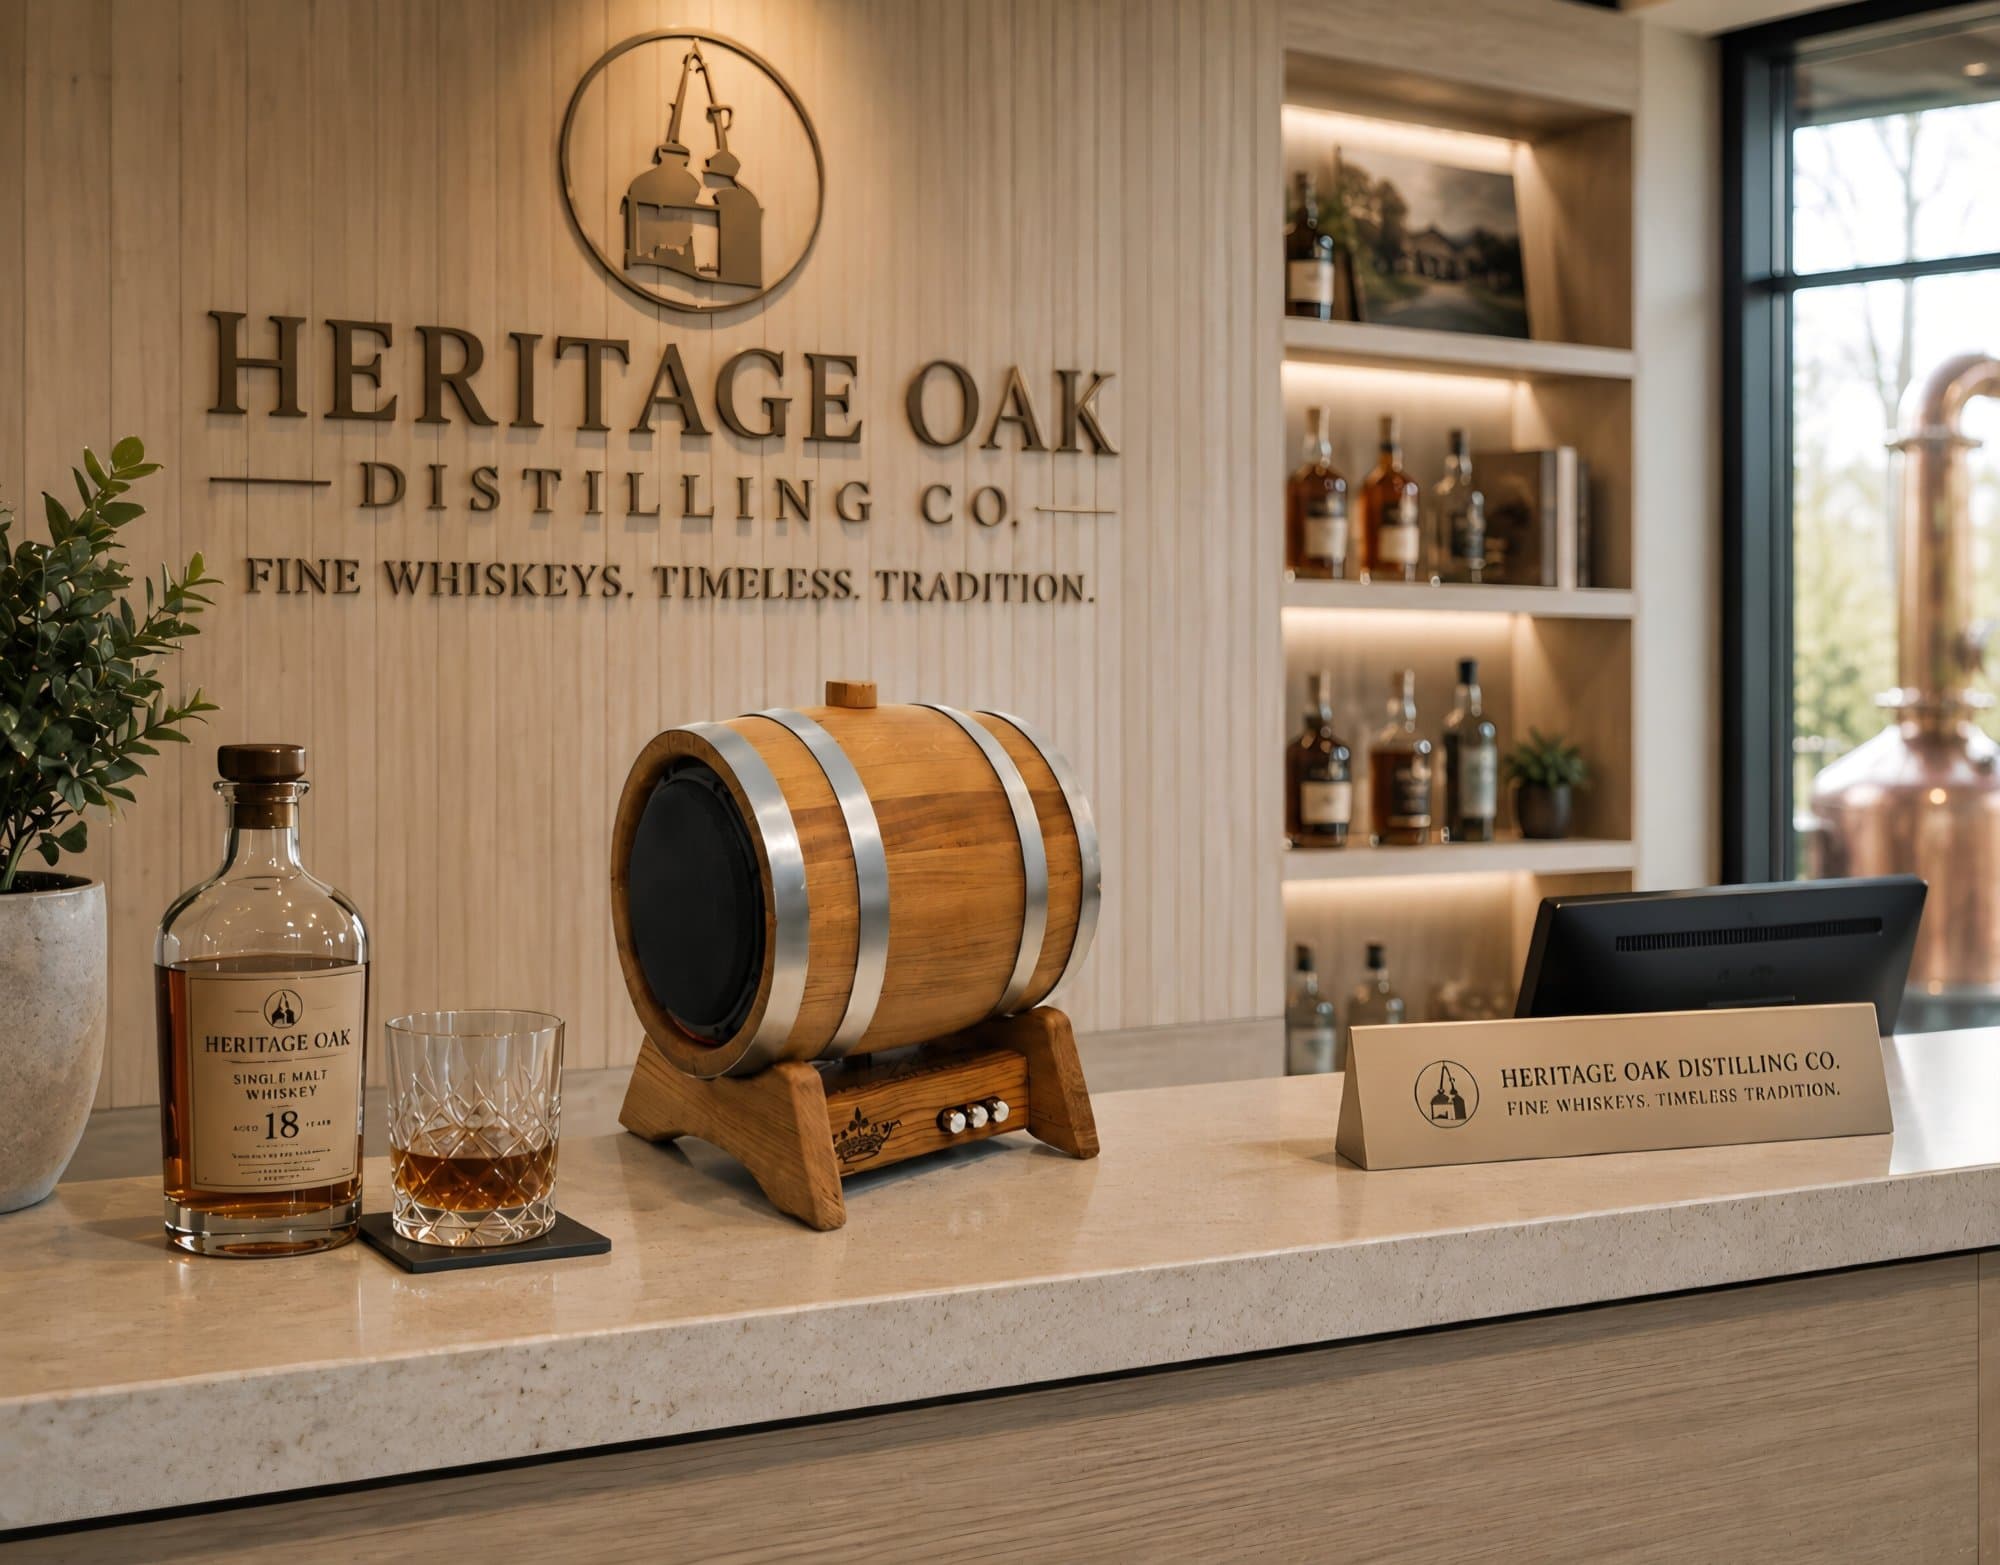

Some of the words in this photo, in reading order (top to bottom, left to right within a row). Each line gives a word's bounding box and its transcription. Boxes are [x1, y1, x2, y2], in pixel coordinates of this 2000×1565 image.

[207, 310, 863, 444] HERITAGE
[905, 359, 1120, 456] OAK
[359, 461, 872, 525] DISTILLING
[920, 484, 1020, 528] CO.
[247, 557, 361, 594] FINE
[383, 559, 634, 600] WHISKEYS.
[652, 565, 860, 600] TIMELESS.
[875, 569, 1096, 603] TRADITION.
[205, 1034, 308, 1053] HERITAGE
[314, 1028, 351, 1049] OAK
[233, 1072, 286, 1086] SINGLE
[292, 1069, 328, 1083] MALT
[1501, 1063, 1616, 1088] HERITAGE
[1624, 1059, 1670, 1082] OAK
[1678, 1053, 1798, 1078] DISTILLING
[1805, 1051, 1840, 1071] CO.
[246, 1085, 317, 1100] WHISKEY
[1507, 1100, 1549, 1116] FINE
[1556, 1094, 1650, 1112] WHISKEYS.
[1744, 1082, 1840, 1101] TRADITION.
[265, 1110, 300, 1140] 18
